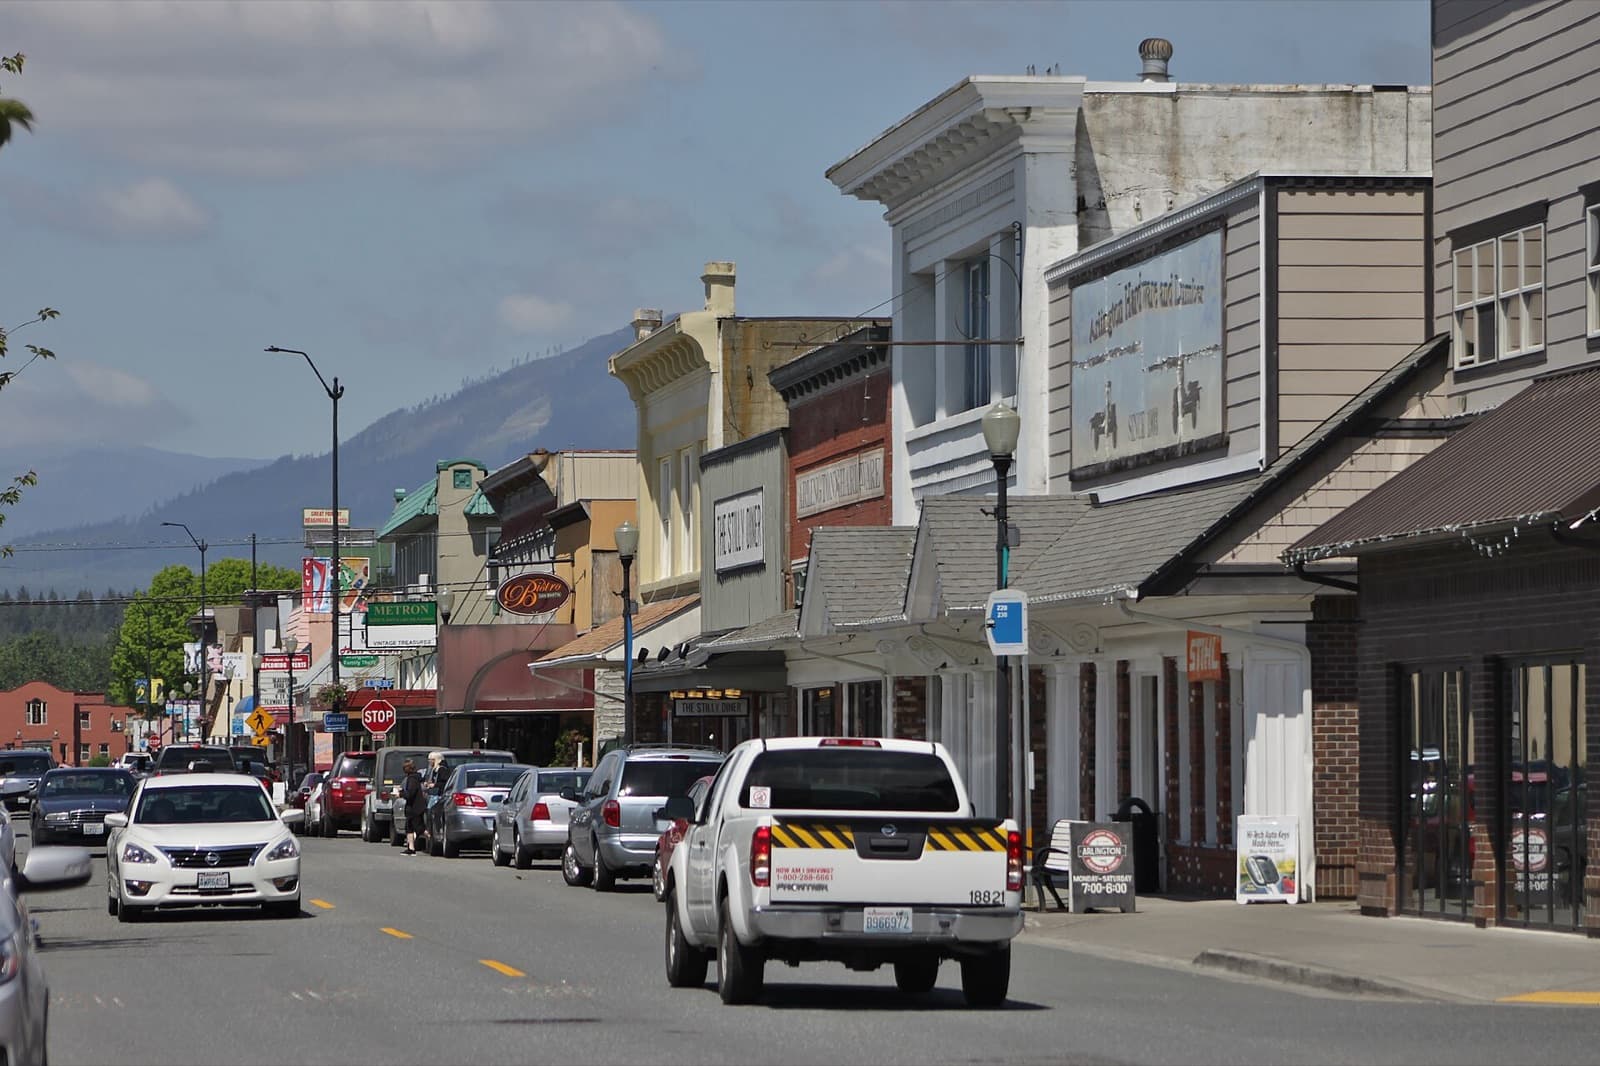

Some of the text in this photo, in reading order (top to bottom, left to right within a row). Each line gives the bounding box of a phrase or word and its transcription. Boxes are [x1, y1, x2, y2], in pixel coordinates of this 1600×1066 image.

[717, 512, 727, 556] THE
[504, 577, 561, 608] Bistro
[374, 604, 428, 616] METRON
[1190, 636, 1219, 672] STIHL
[682, 702, 743, 712] THE STILLY DINER
[364, 710, 393, 722] STOP
[1247, 830, 1290, 840] Hi-Tech Auto Keys
[1082, 847, 1122, 856] ARLINGTON
[1082, 882, 1128, 894] 7:00-6:00
[969, 890, 1005, 904] 18821
